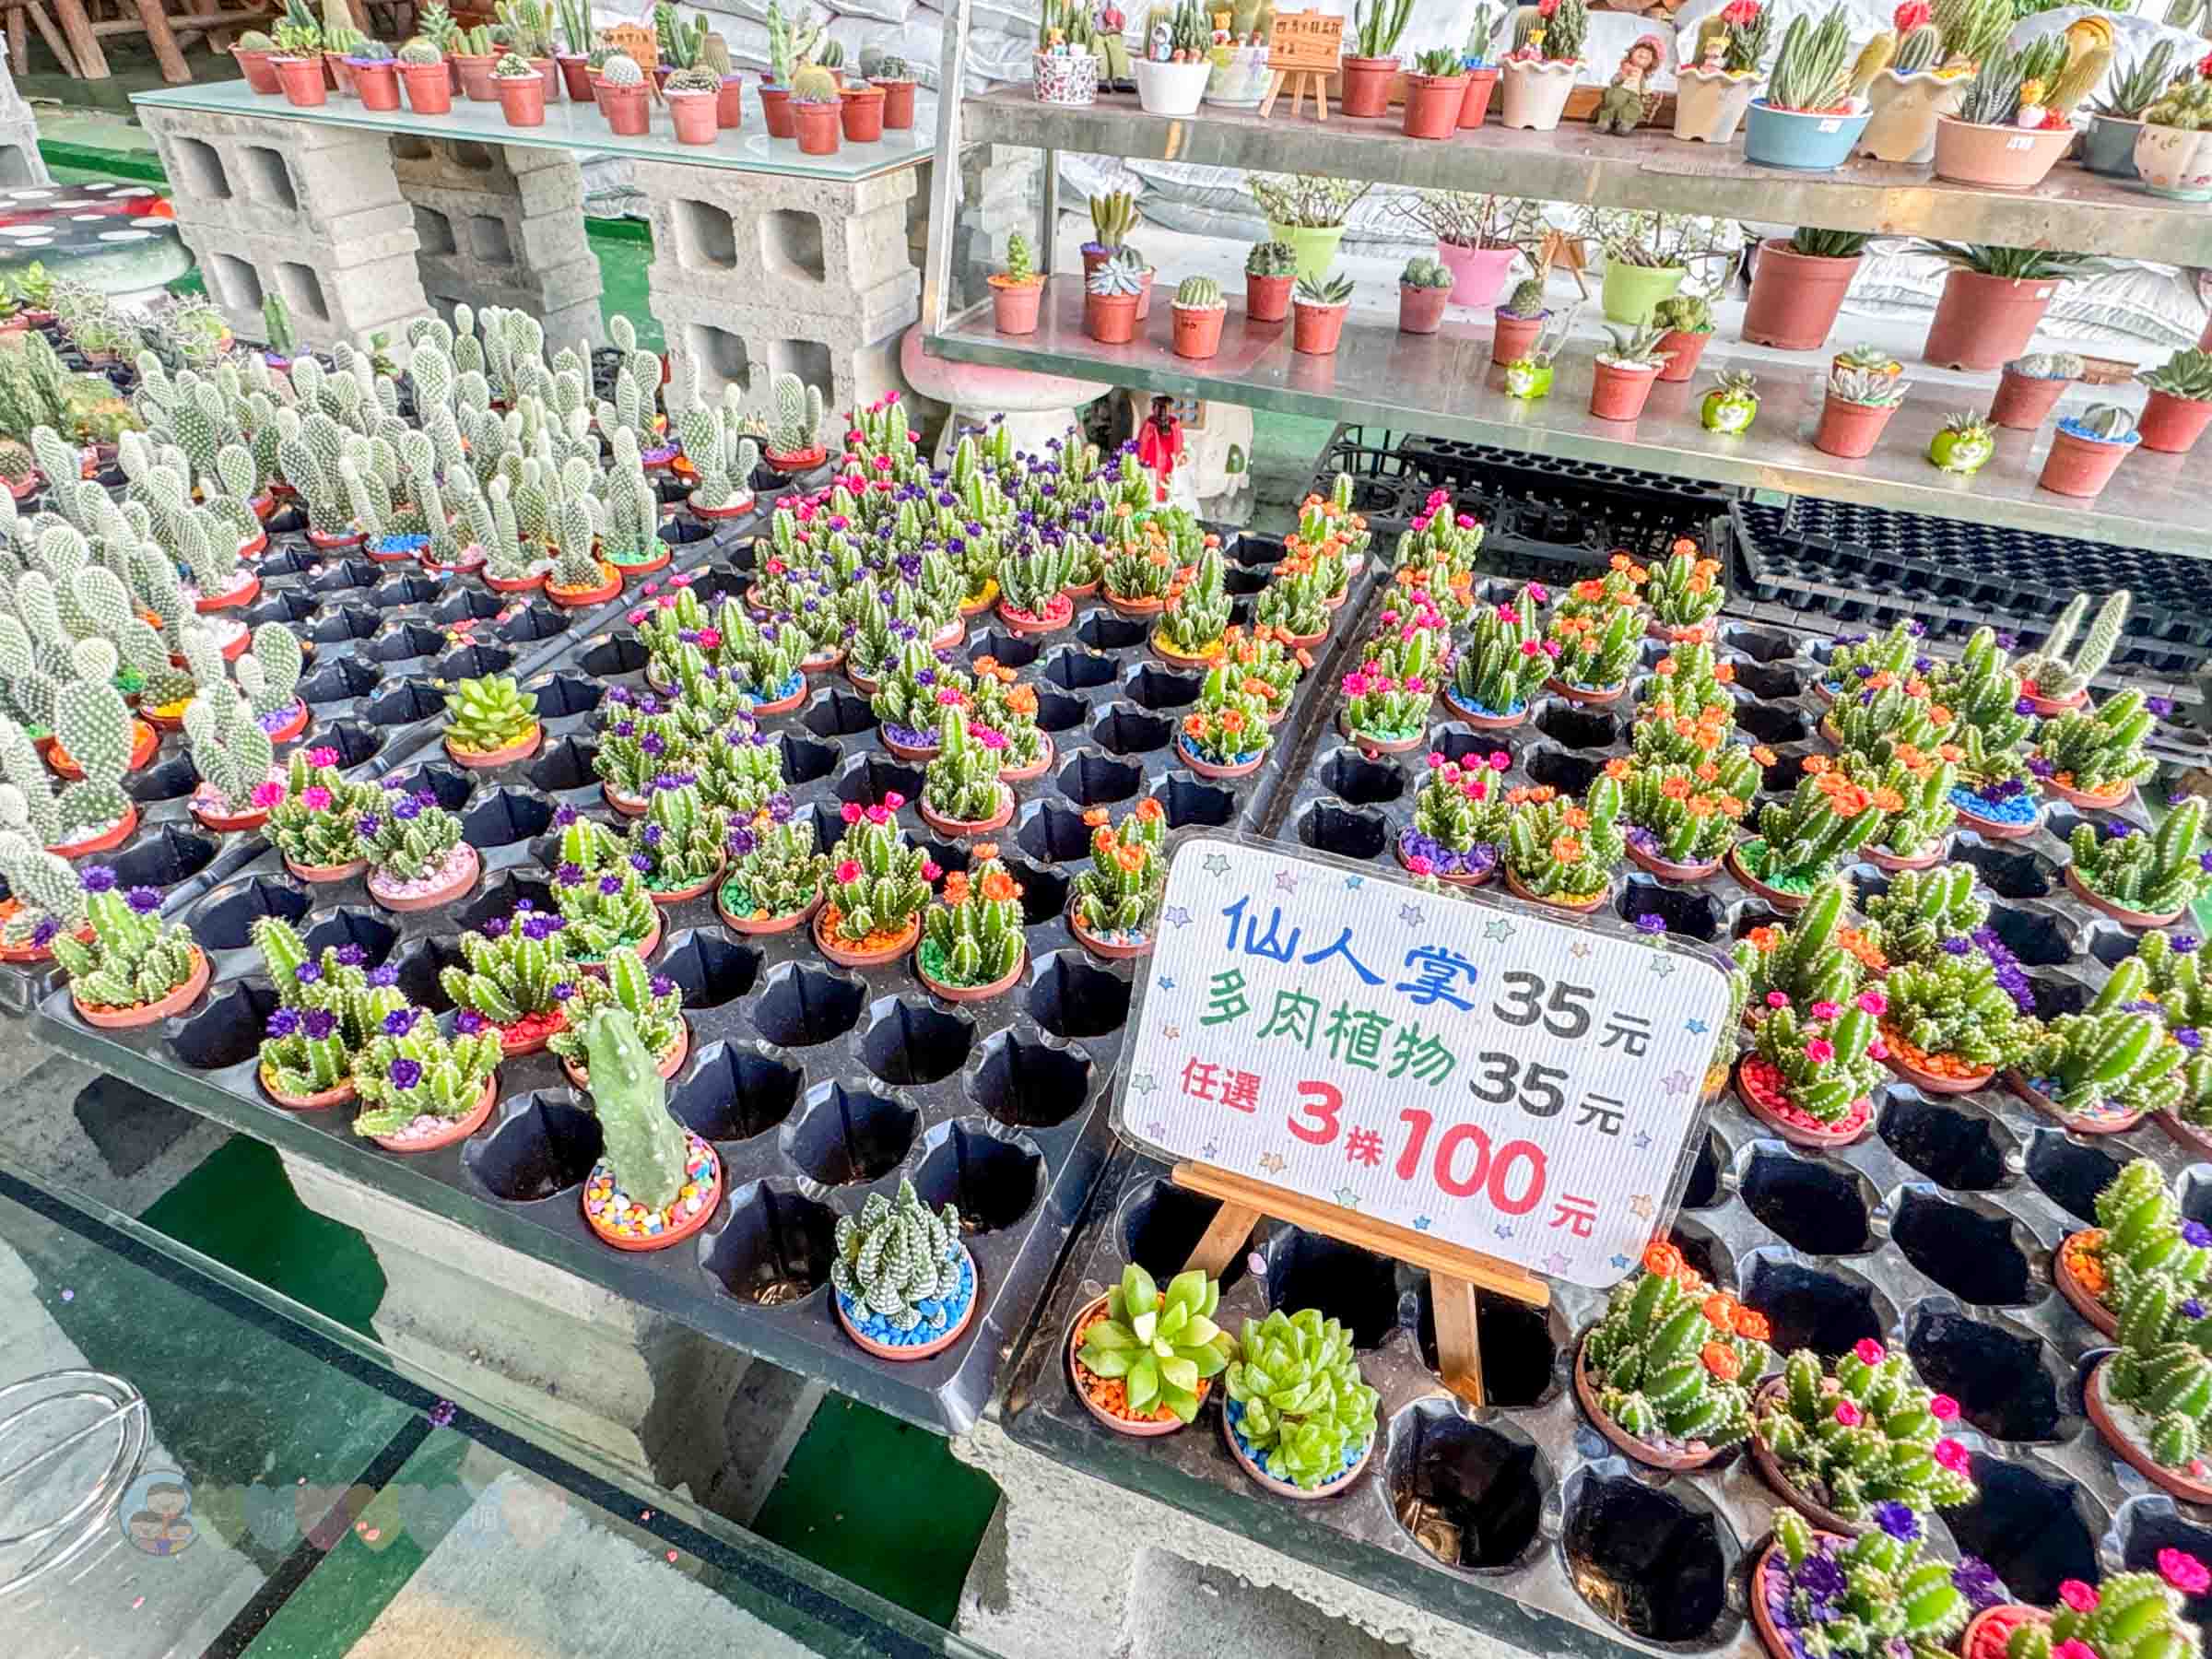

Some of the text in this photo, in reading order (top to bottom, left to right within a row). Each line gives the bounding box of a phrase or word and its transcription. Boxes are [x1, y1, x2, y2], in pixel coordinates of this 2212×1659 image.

[1222, 896, 1477, 1011] 仙人掌
[1200, 968, 1455, 1087] 多肉植物
